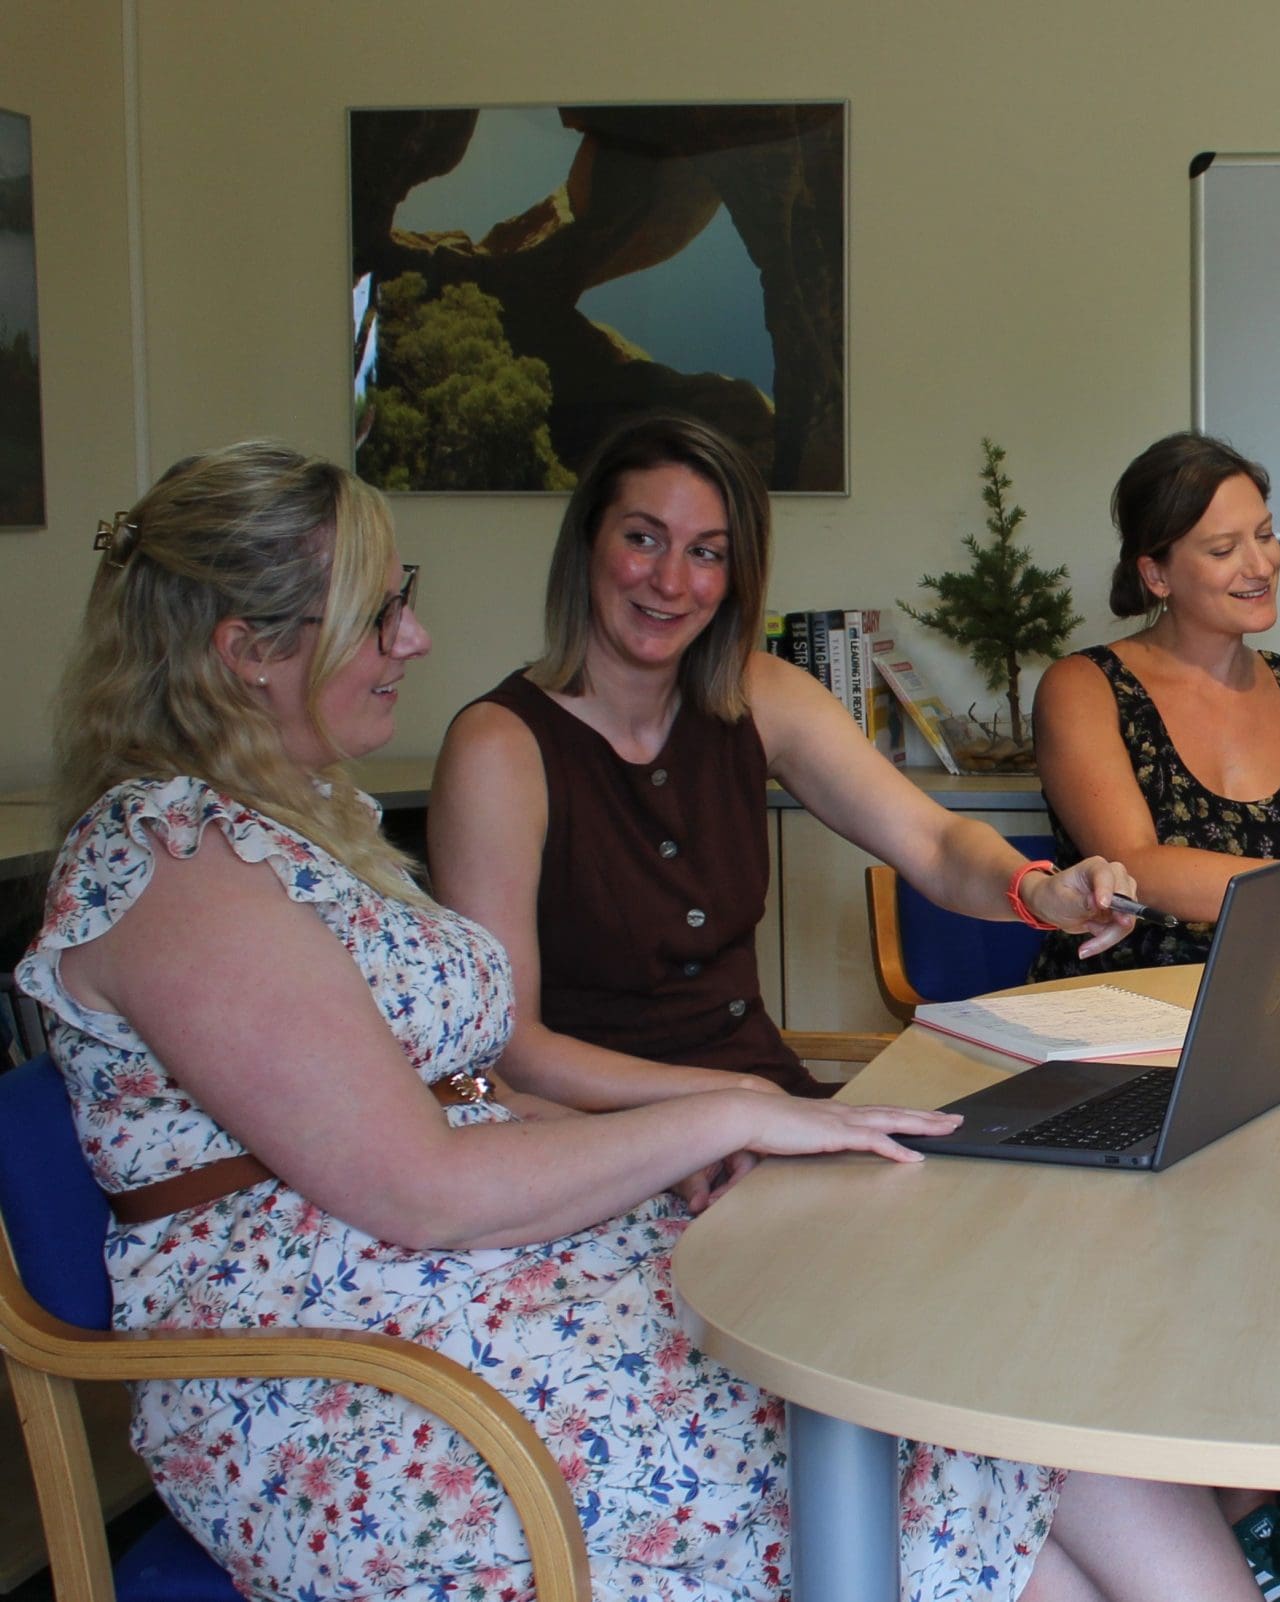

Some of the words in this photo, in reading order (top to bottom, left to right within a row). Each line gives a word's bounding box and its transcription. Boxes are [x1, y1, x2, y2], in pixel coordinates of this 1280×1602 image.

[815, 620, 827, 663] LIVING
[850, 640, 861, 678] LEADING
[852, 679, 862, 695] THE
